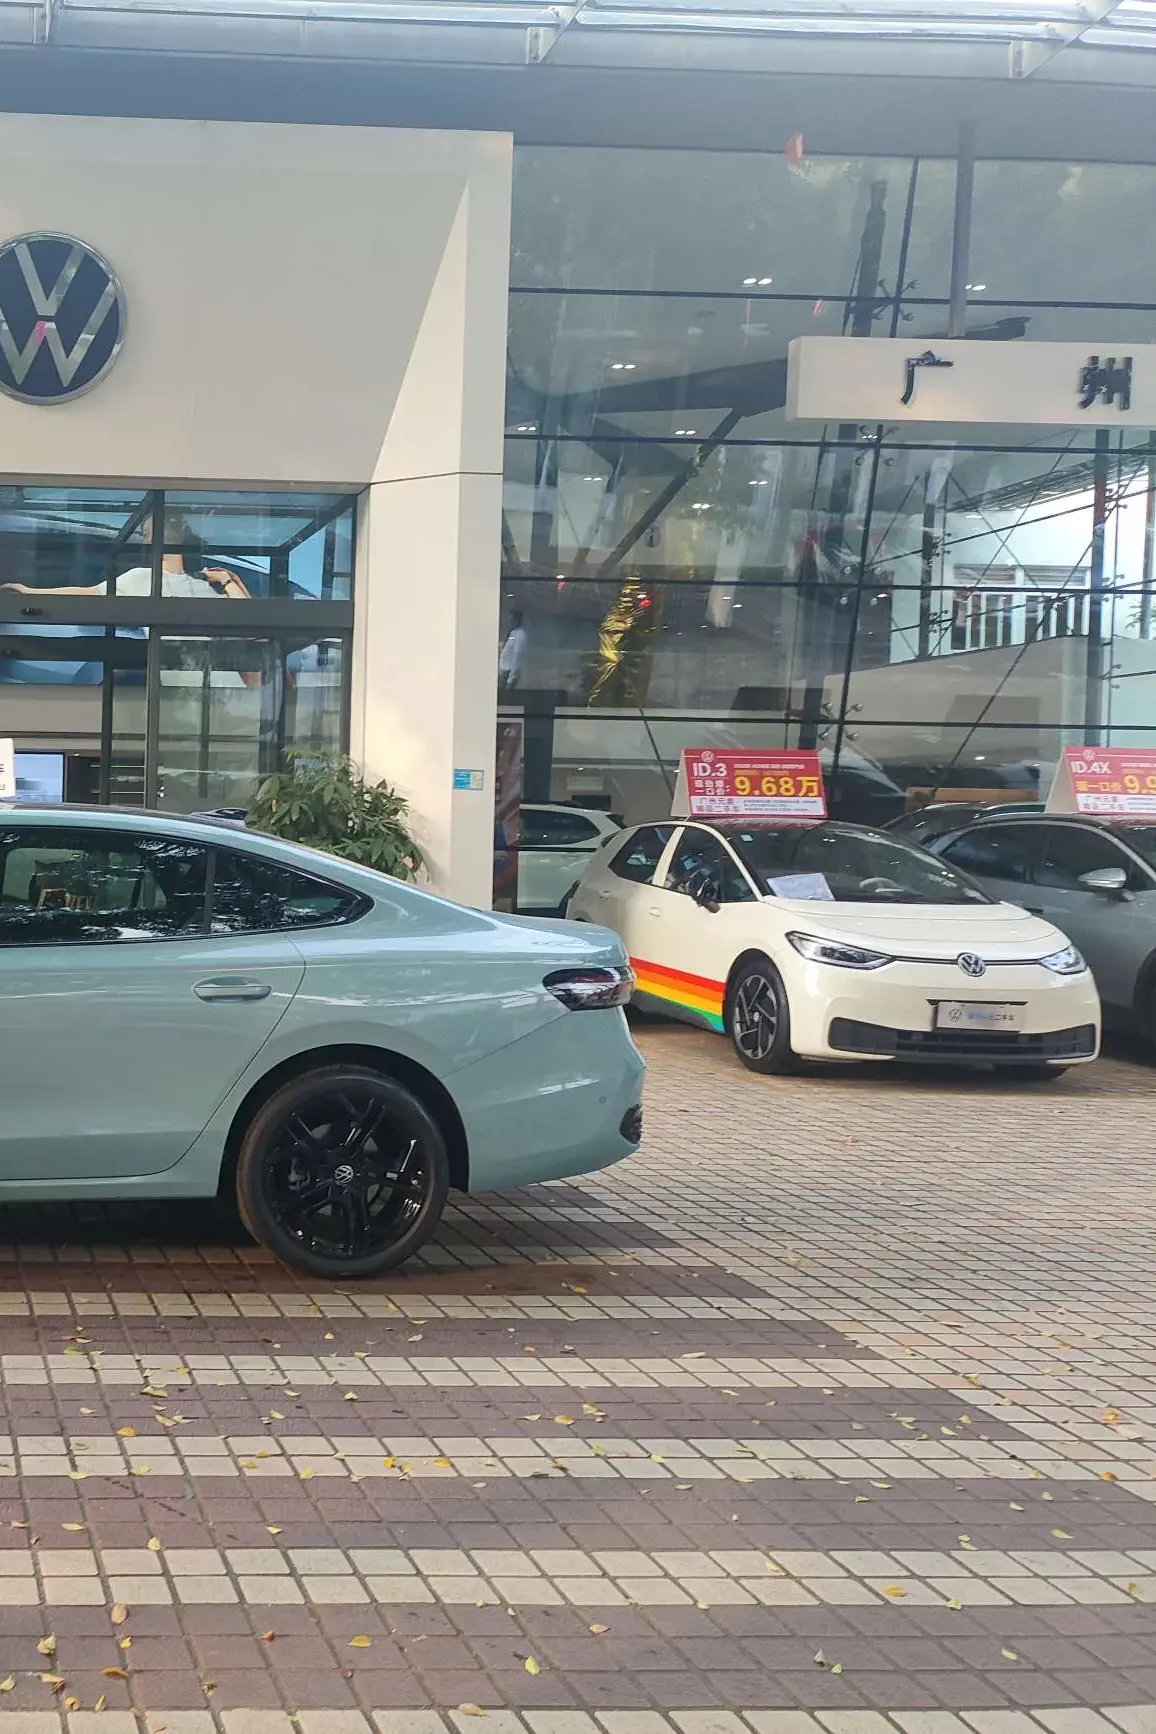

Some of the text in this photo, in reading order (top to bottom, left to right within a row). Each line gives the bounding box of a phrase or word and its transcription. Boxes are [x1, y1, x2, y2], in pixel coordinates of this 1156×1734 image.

[901, 350, 1133, 412] 广州
[692, 762, 727, 777] ID.3
[1071, 761, 1113, 774] ID.4X
[734, 776, 820, 797] 9.68万
